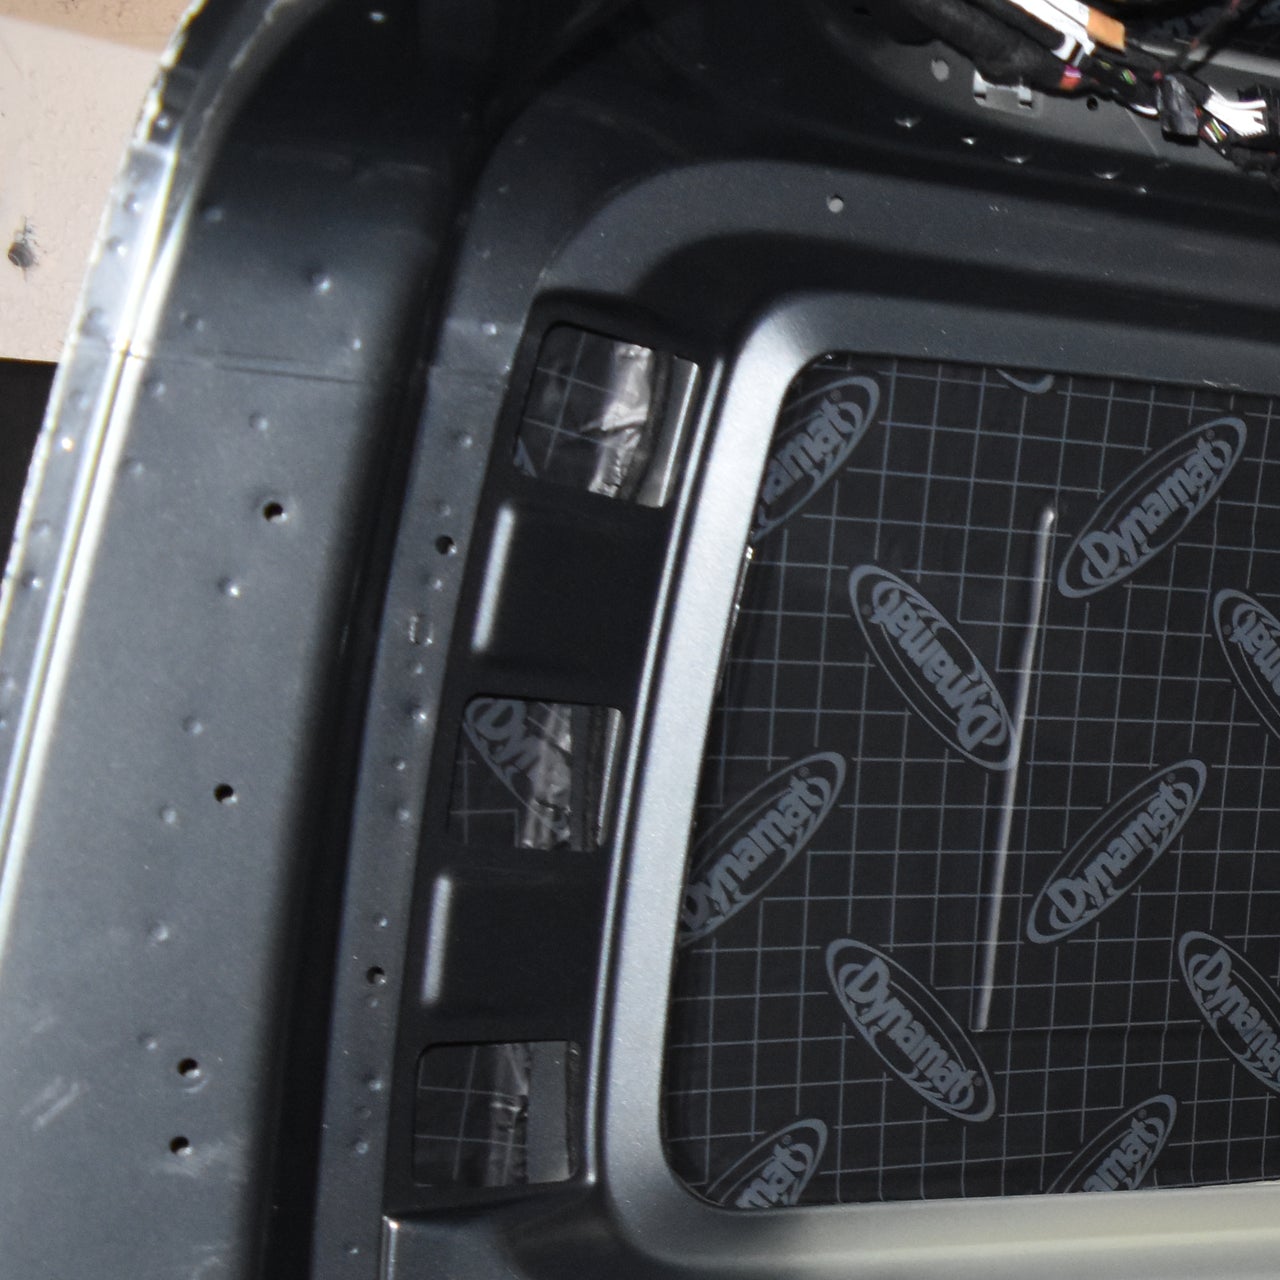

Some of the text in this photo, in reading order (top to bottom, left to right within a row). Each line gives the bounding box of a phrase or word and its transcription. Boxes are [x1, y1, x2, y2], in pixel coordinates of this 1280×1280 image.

[1080, 437, 1232, 586] Dynamat
[869, 580, 1008, 751] Dynamat
[681, 775, 832, 932] Dynamat
[1047, 778, 1194, 931] Dynamat
[838, 956, 978, 1111] Dynamat
